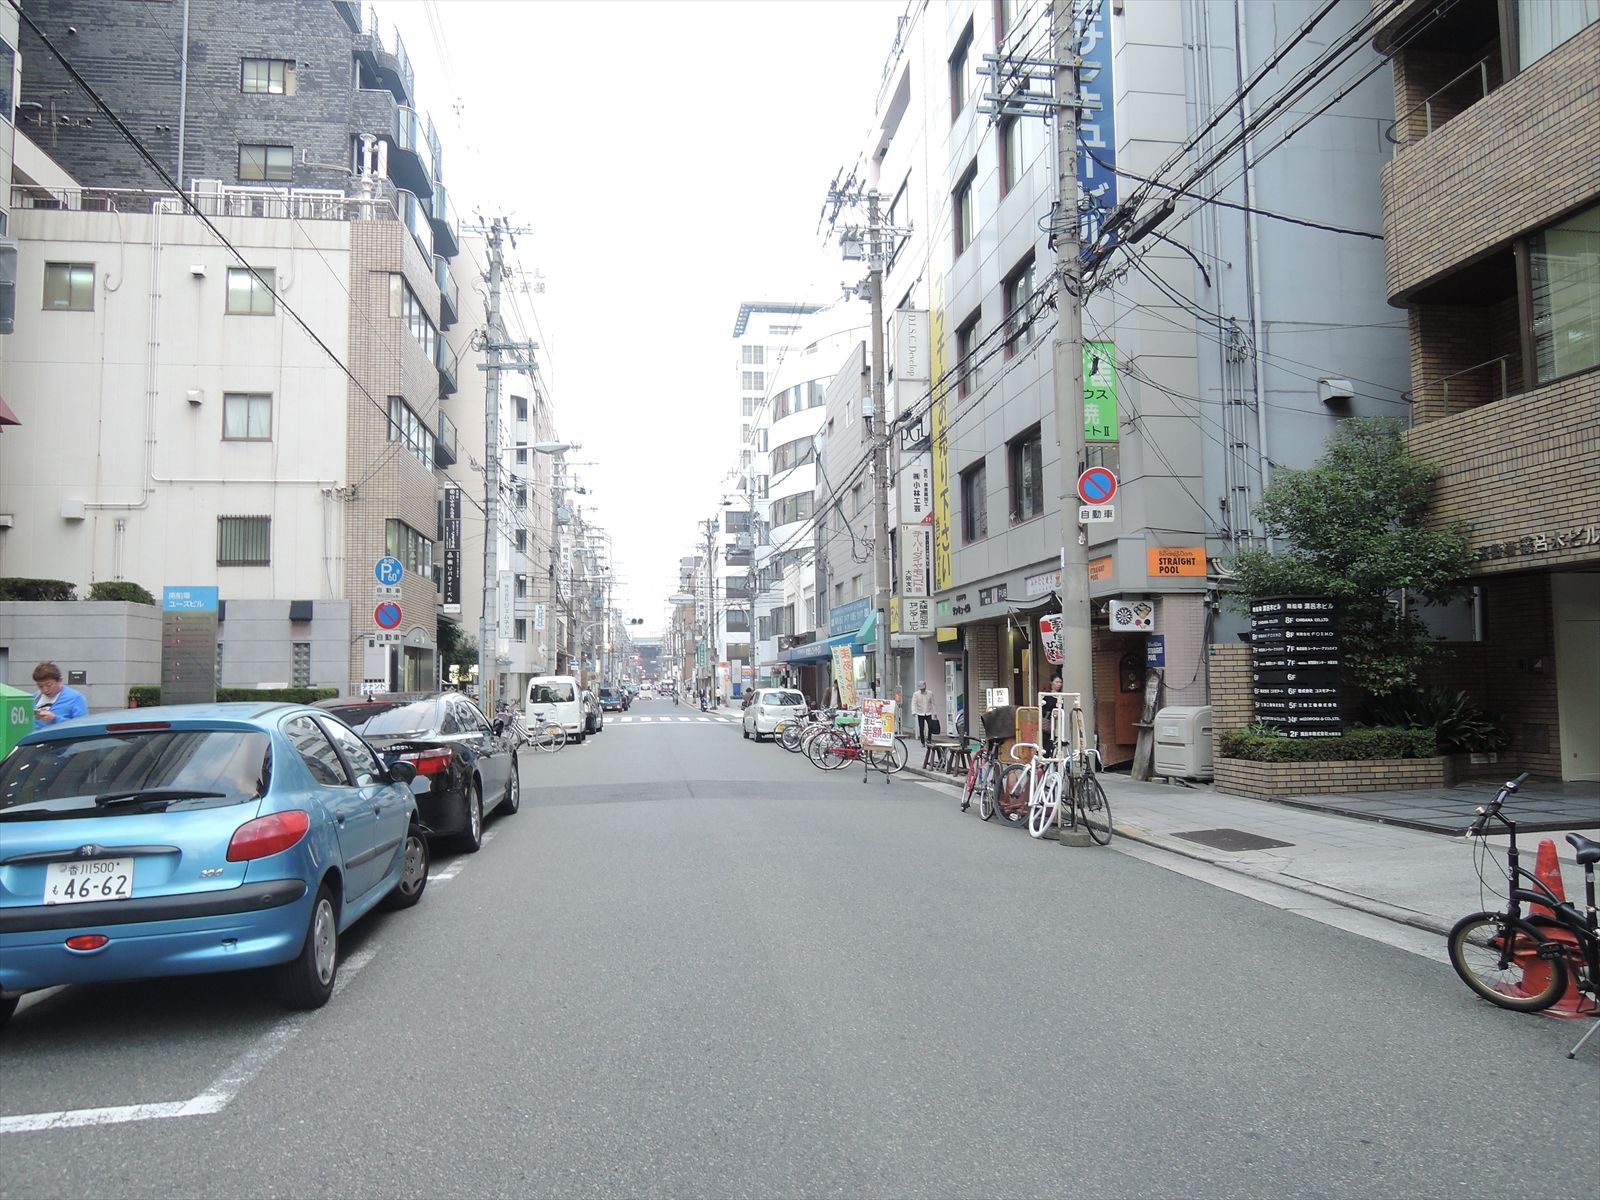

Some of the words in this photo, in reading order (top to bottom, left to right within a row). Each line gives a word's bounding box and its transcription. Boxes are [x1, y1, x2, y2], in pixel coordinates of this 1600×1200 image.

[1081, 509, 1113, 520] 自動車
[1158, 557, 1196, 566] STRAIGHT
[381, 563, 392, 581] P
[1159, 566, 1180, 574] POOL
[387, 573, 397, 581] 60
[1285, 616, 1294, 624] 8F
[1286, 645, 1295, 653] 7F
[1287, 659, 1296, 667] 7F
[1287, 673, 1297, 681] 6F
[1288, 701, 1297, 709] 5F
[863, 717, 887, 726] 生ビール
[1289, 730, 1298, 738] 2F
[64, 875, 127, 899] 46-62
